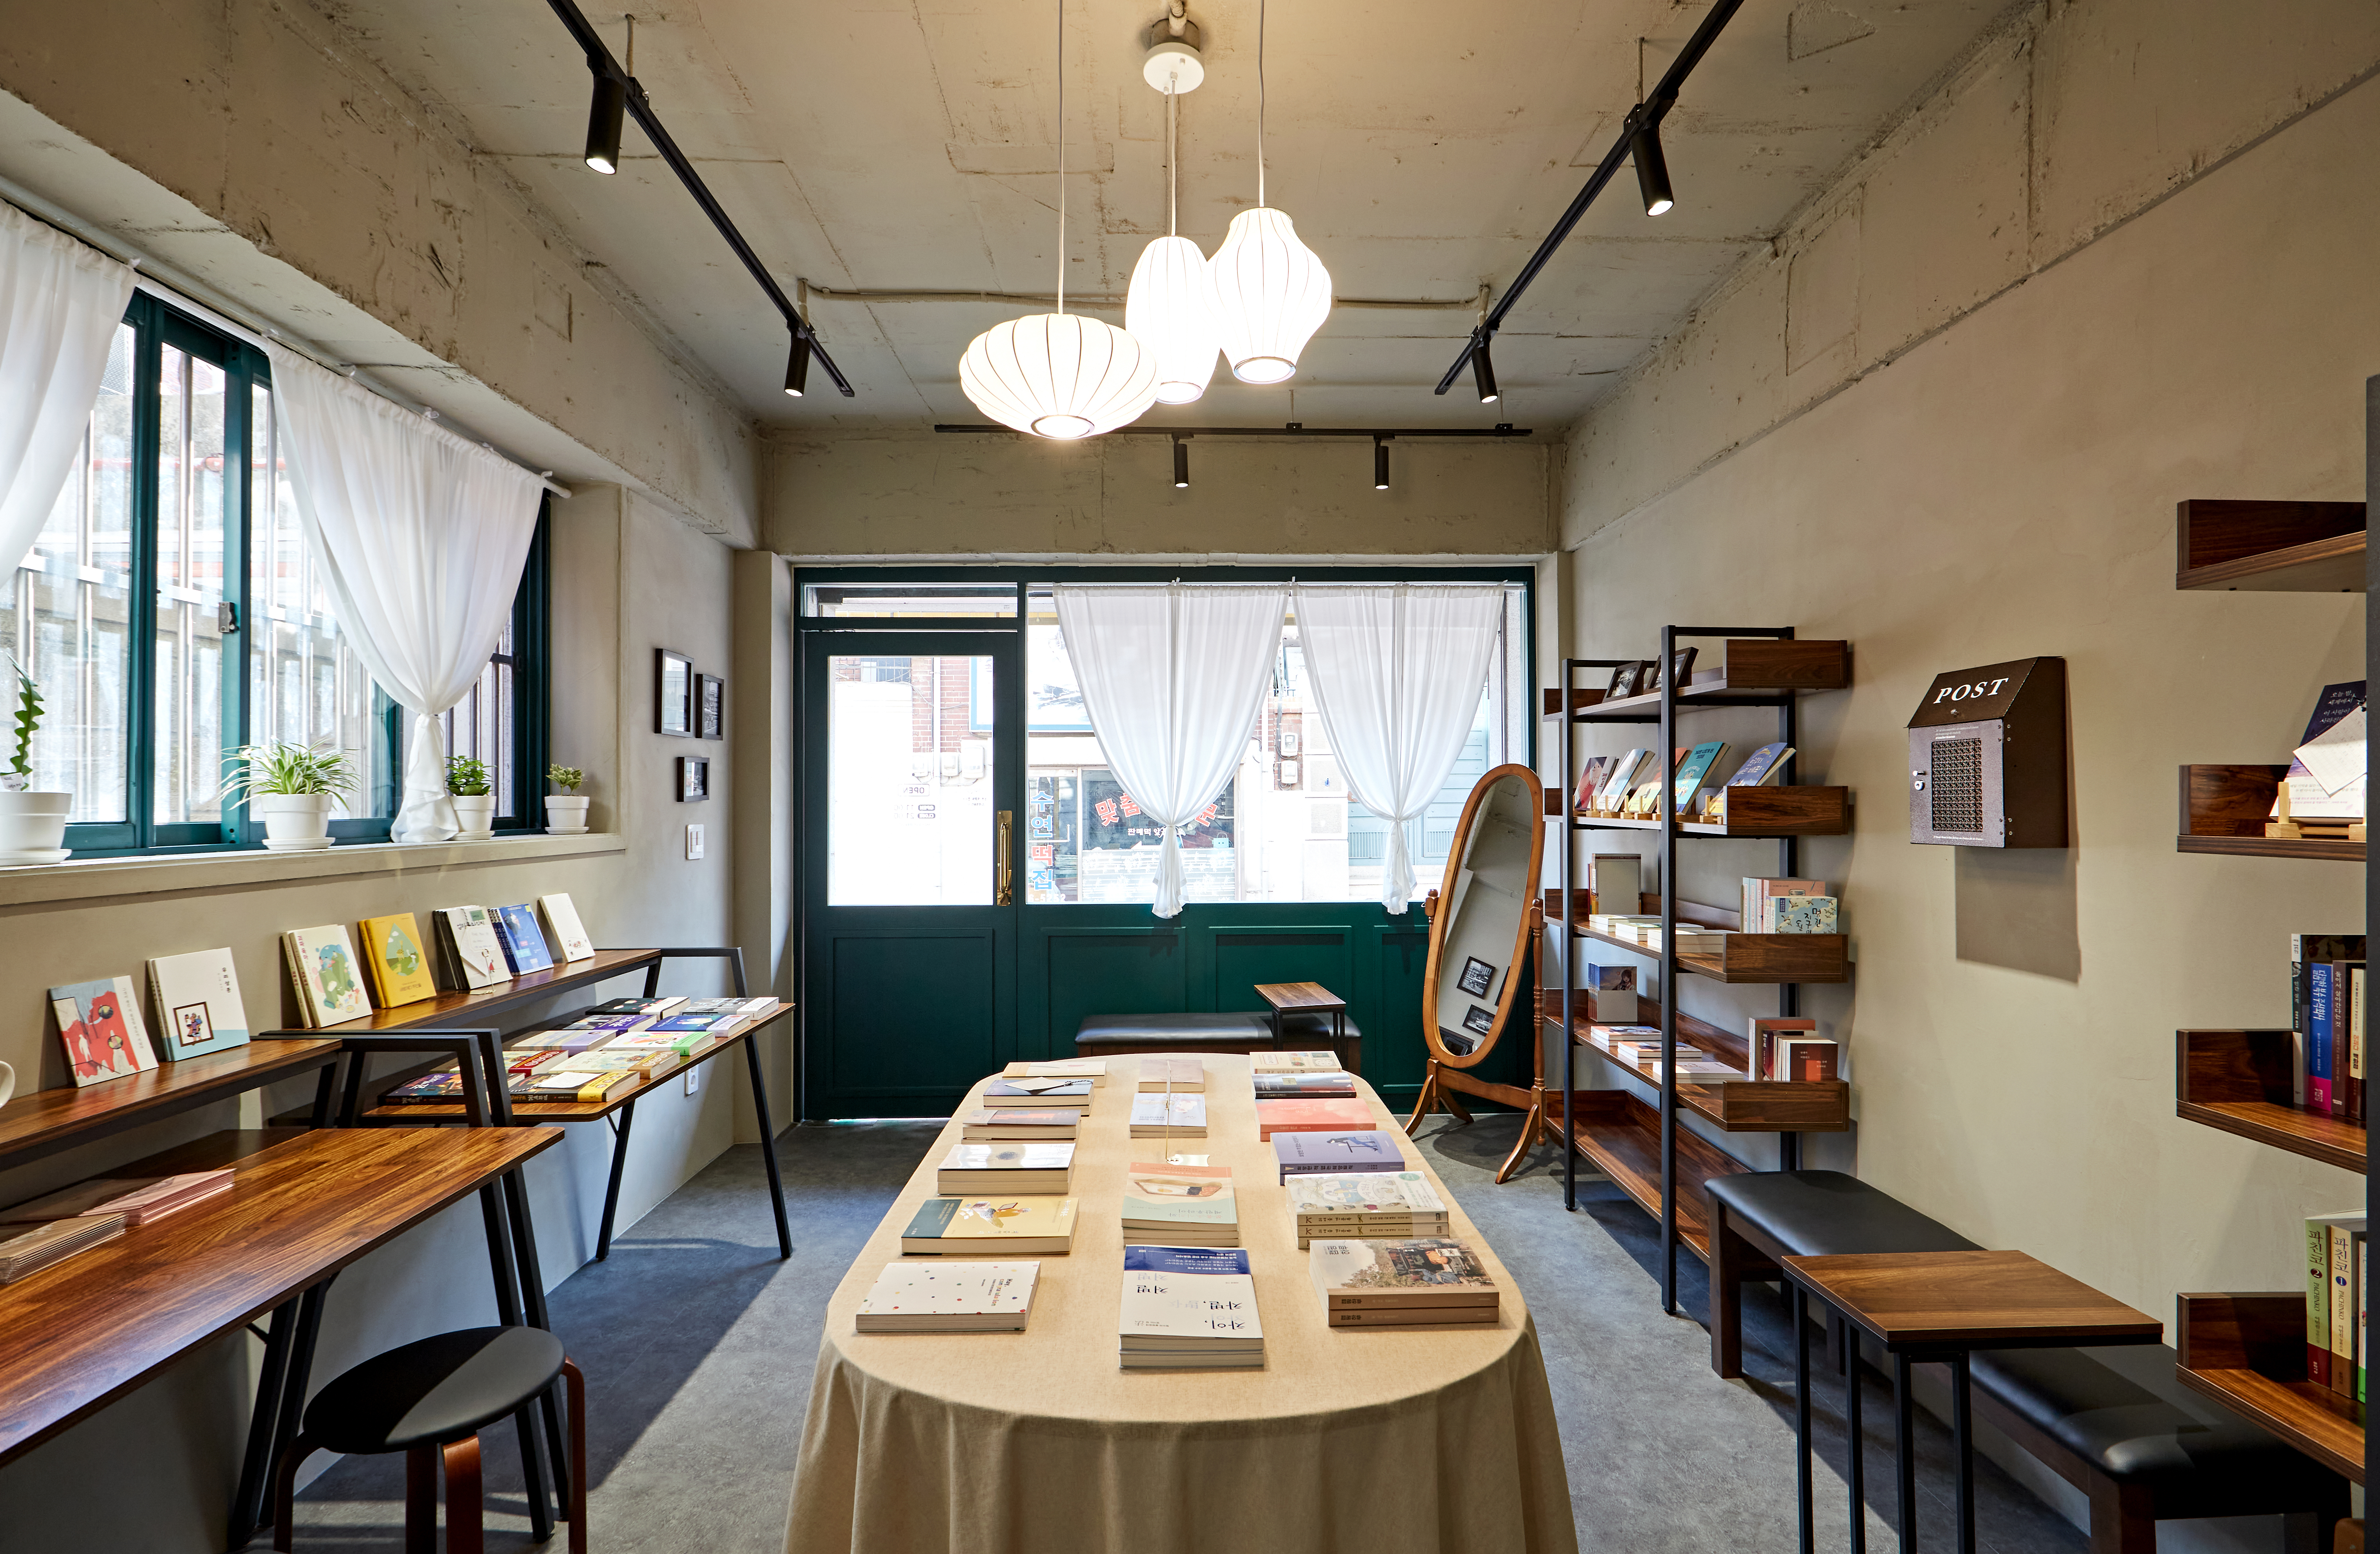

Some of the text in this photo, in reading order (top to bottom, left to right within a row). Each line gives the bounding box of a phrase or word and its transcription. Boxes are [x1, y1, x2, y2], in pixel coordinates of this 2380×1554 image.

[1933, 677, 2009, 704] POST
[1812, 908, 1821, 927] 멋진
[1796, 920, 1803, 931] 될
[2313, 970, 2327, 1020] 달콤한 복수 주식회사
[1327, 1245, 1339, 1255] 캠핑
[1339, 1245, 1350, 1255] 하루
[2309, 1230, 2324, 1266] 파친코
[2333, 1237, 2349, 1273] 파친코
[2313, 1269, 2320, 1278] 2
[991, 1279, 1004, 1306] congratulation
[1136, 1285, 1168, 1294] 처벌
[1203, 1301, 1243, 1310] 차별,
[1204, 1320, 1246, 1330] 차이,
